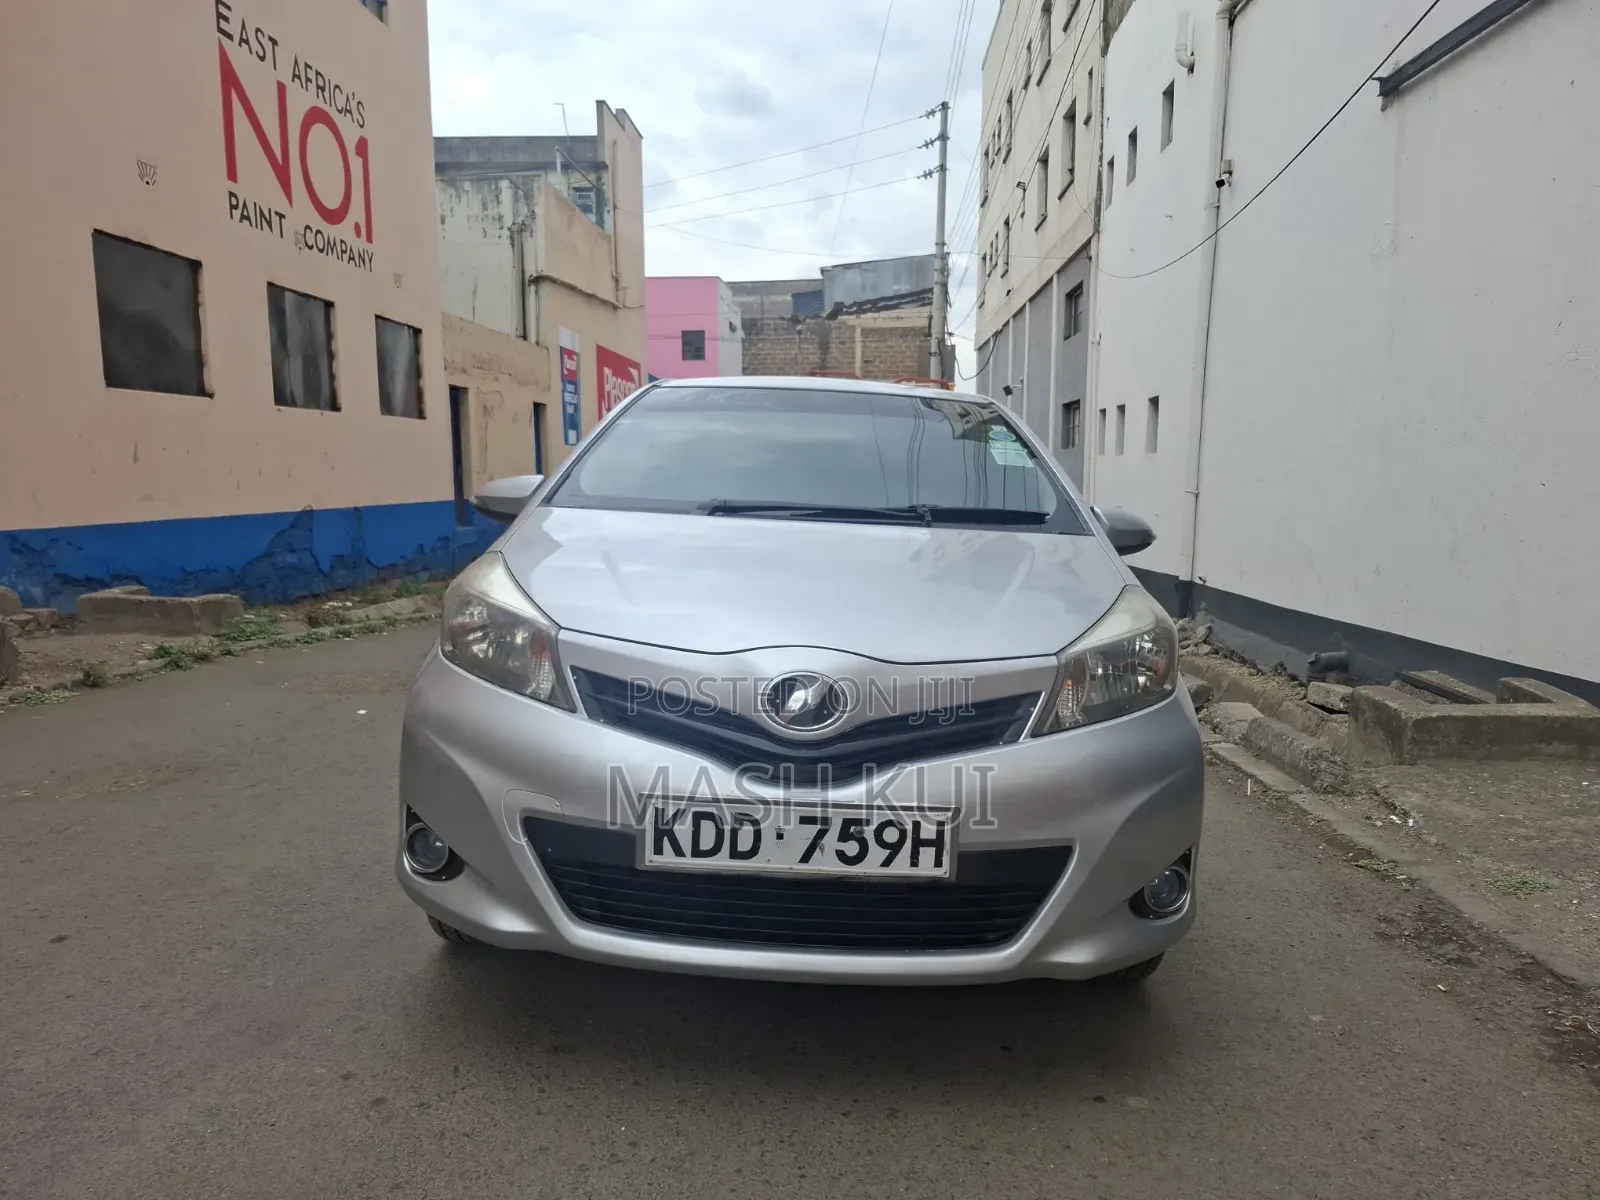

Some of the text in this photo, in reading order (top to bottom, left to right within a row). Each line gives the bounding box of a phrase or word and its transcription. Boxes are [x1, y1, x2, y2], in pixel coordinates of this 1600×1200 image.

[215, 0, 365, 129] EAST AFRICA'S
[218, 37, 373, 244] NO.1
[228, 190, 374, 273] PAINT COMPANY
[603, 366, 637, 412] Plasc
[653, 806, 946, 869] KDD 759H
